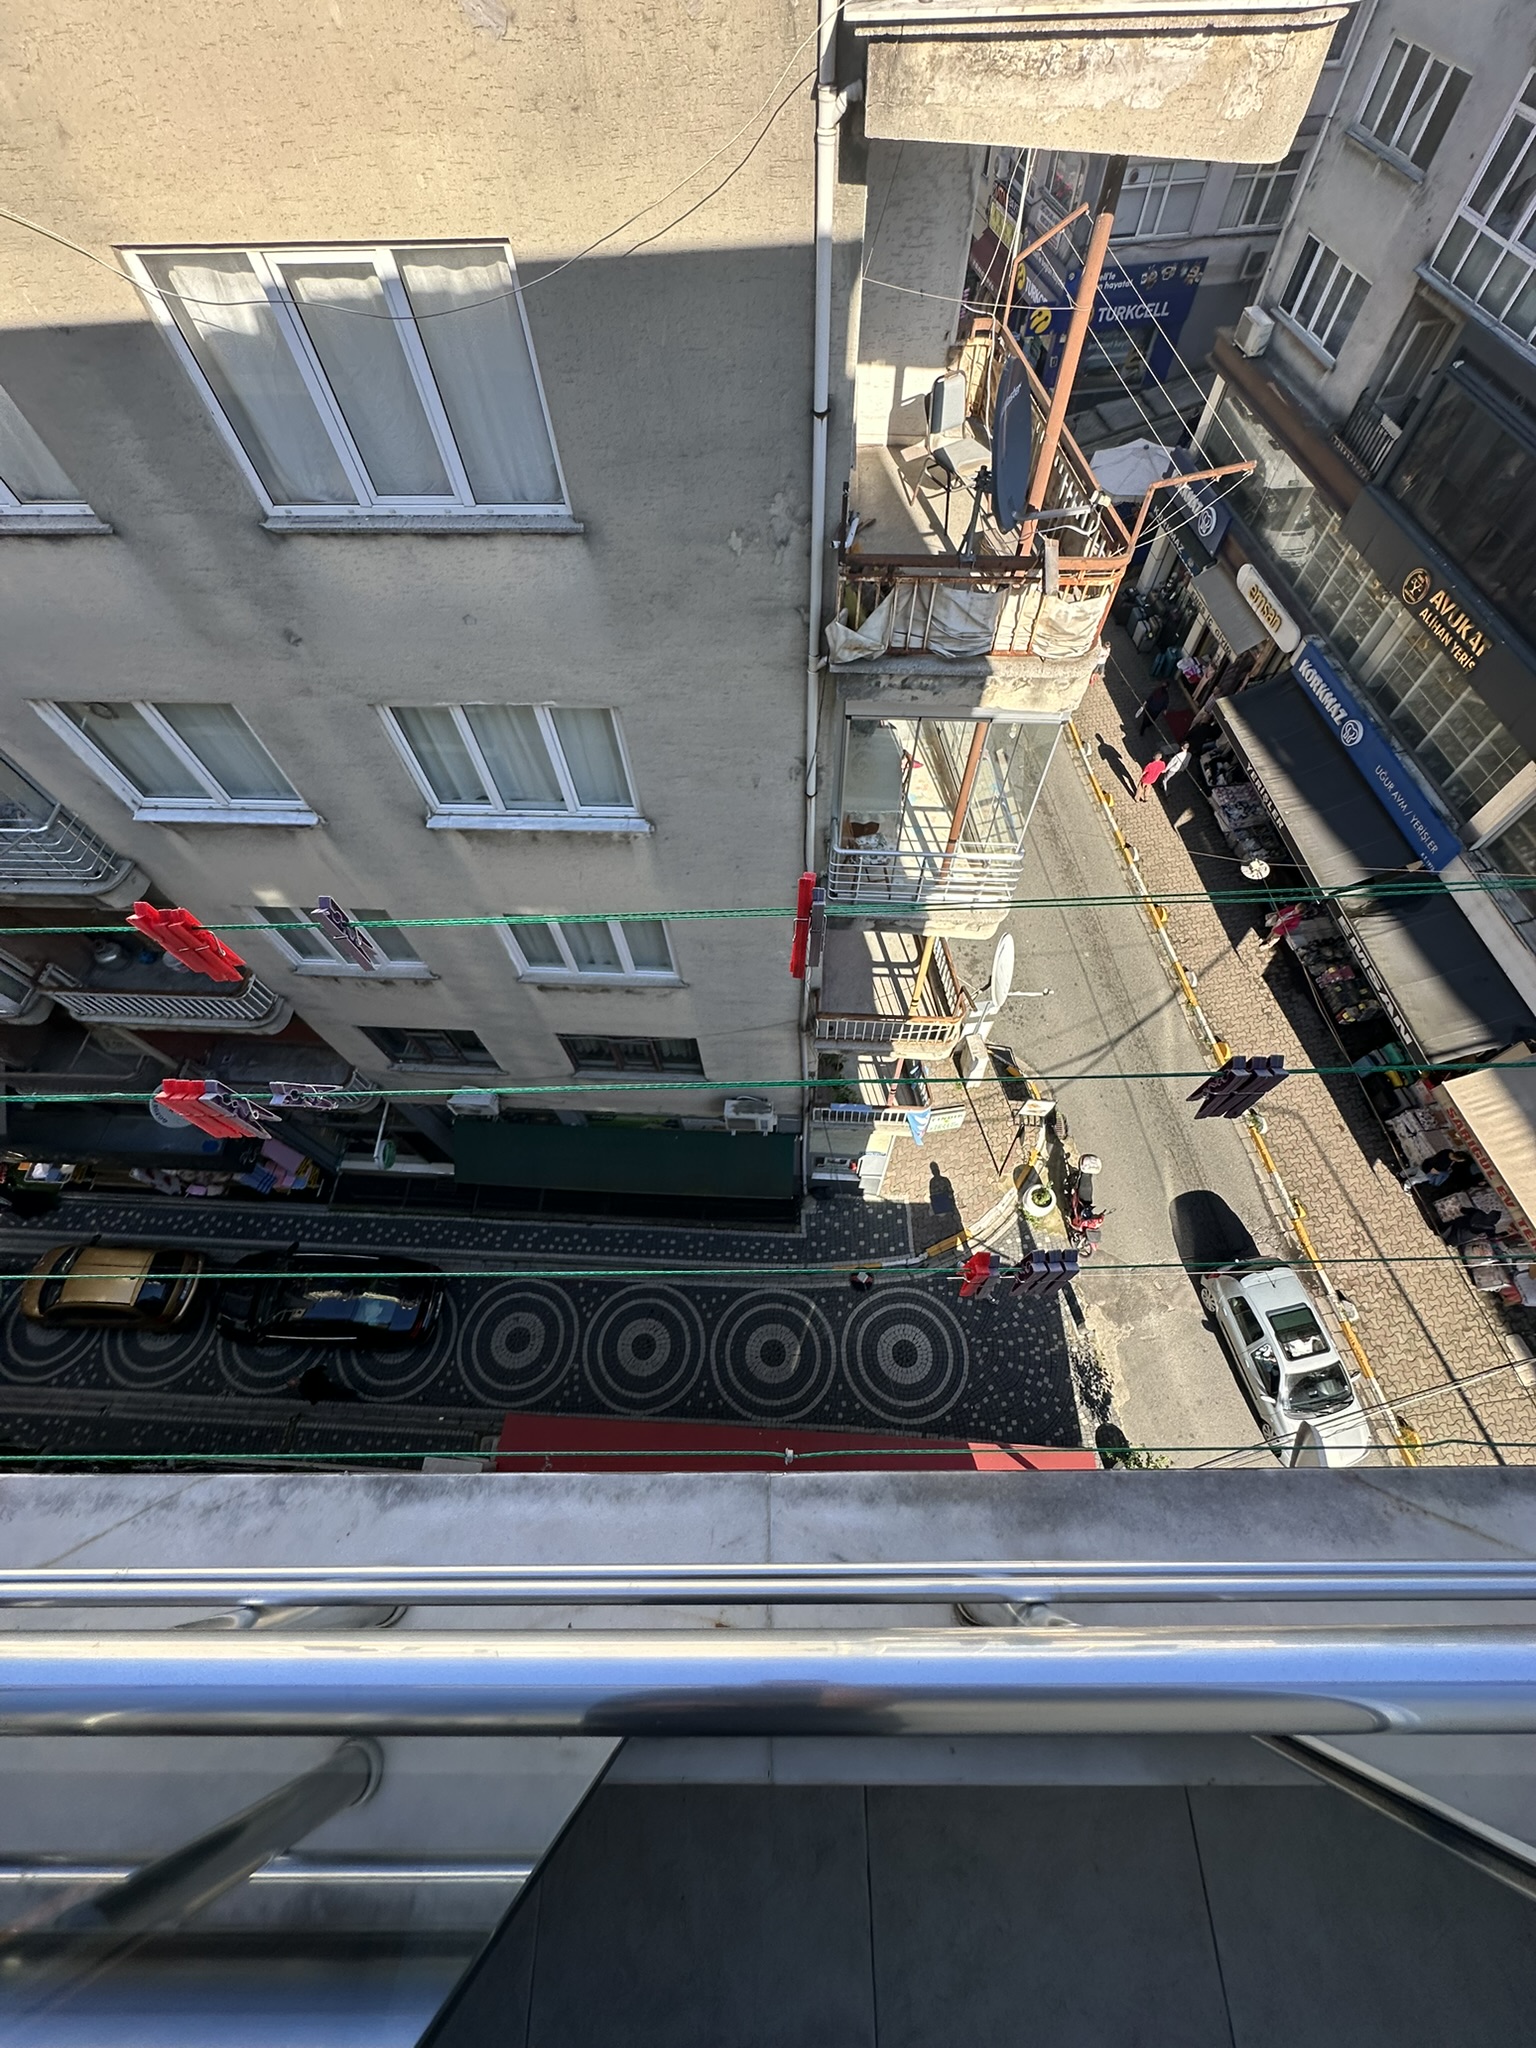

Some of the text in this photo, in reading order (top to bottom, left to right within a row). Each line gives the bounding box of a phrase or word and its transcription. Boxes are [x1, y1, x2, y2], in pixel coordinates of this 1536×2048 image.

[1098, 301, 1170, 323] TURKCELL
[1248, 583, 1282, 633] emsan
[1418, 606, 1453, 647] ALİHAN
[1429, 589, 1493, 657] AVUKAT
[1298, 658, 1348, 726] KORKMAZ
[1391, 791, 1408, 812] AVM
[1337, 915, 1413, 1046] EMSAN
[1446, 1106, 1496, 1180] SARIGÜL
[1496, 1185, 1516, 1208] EV
